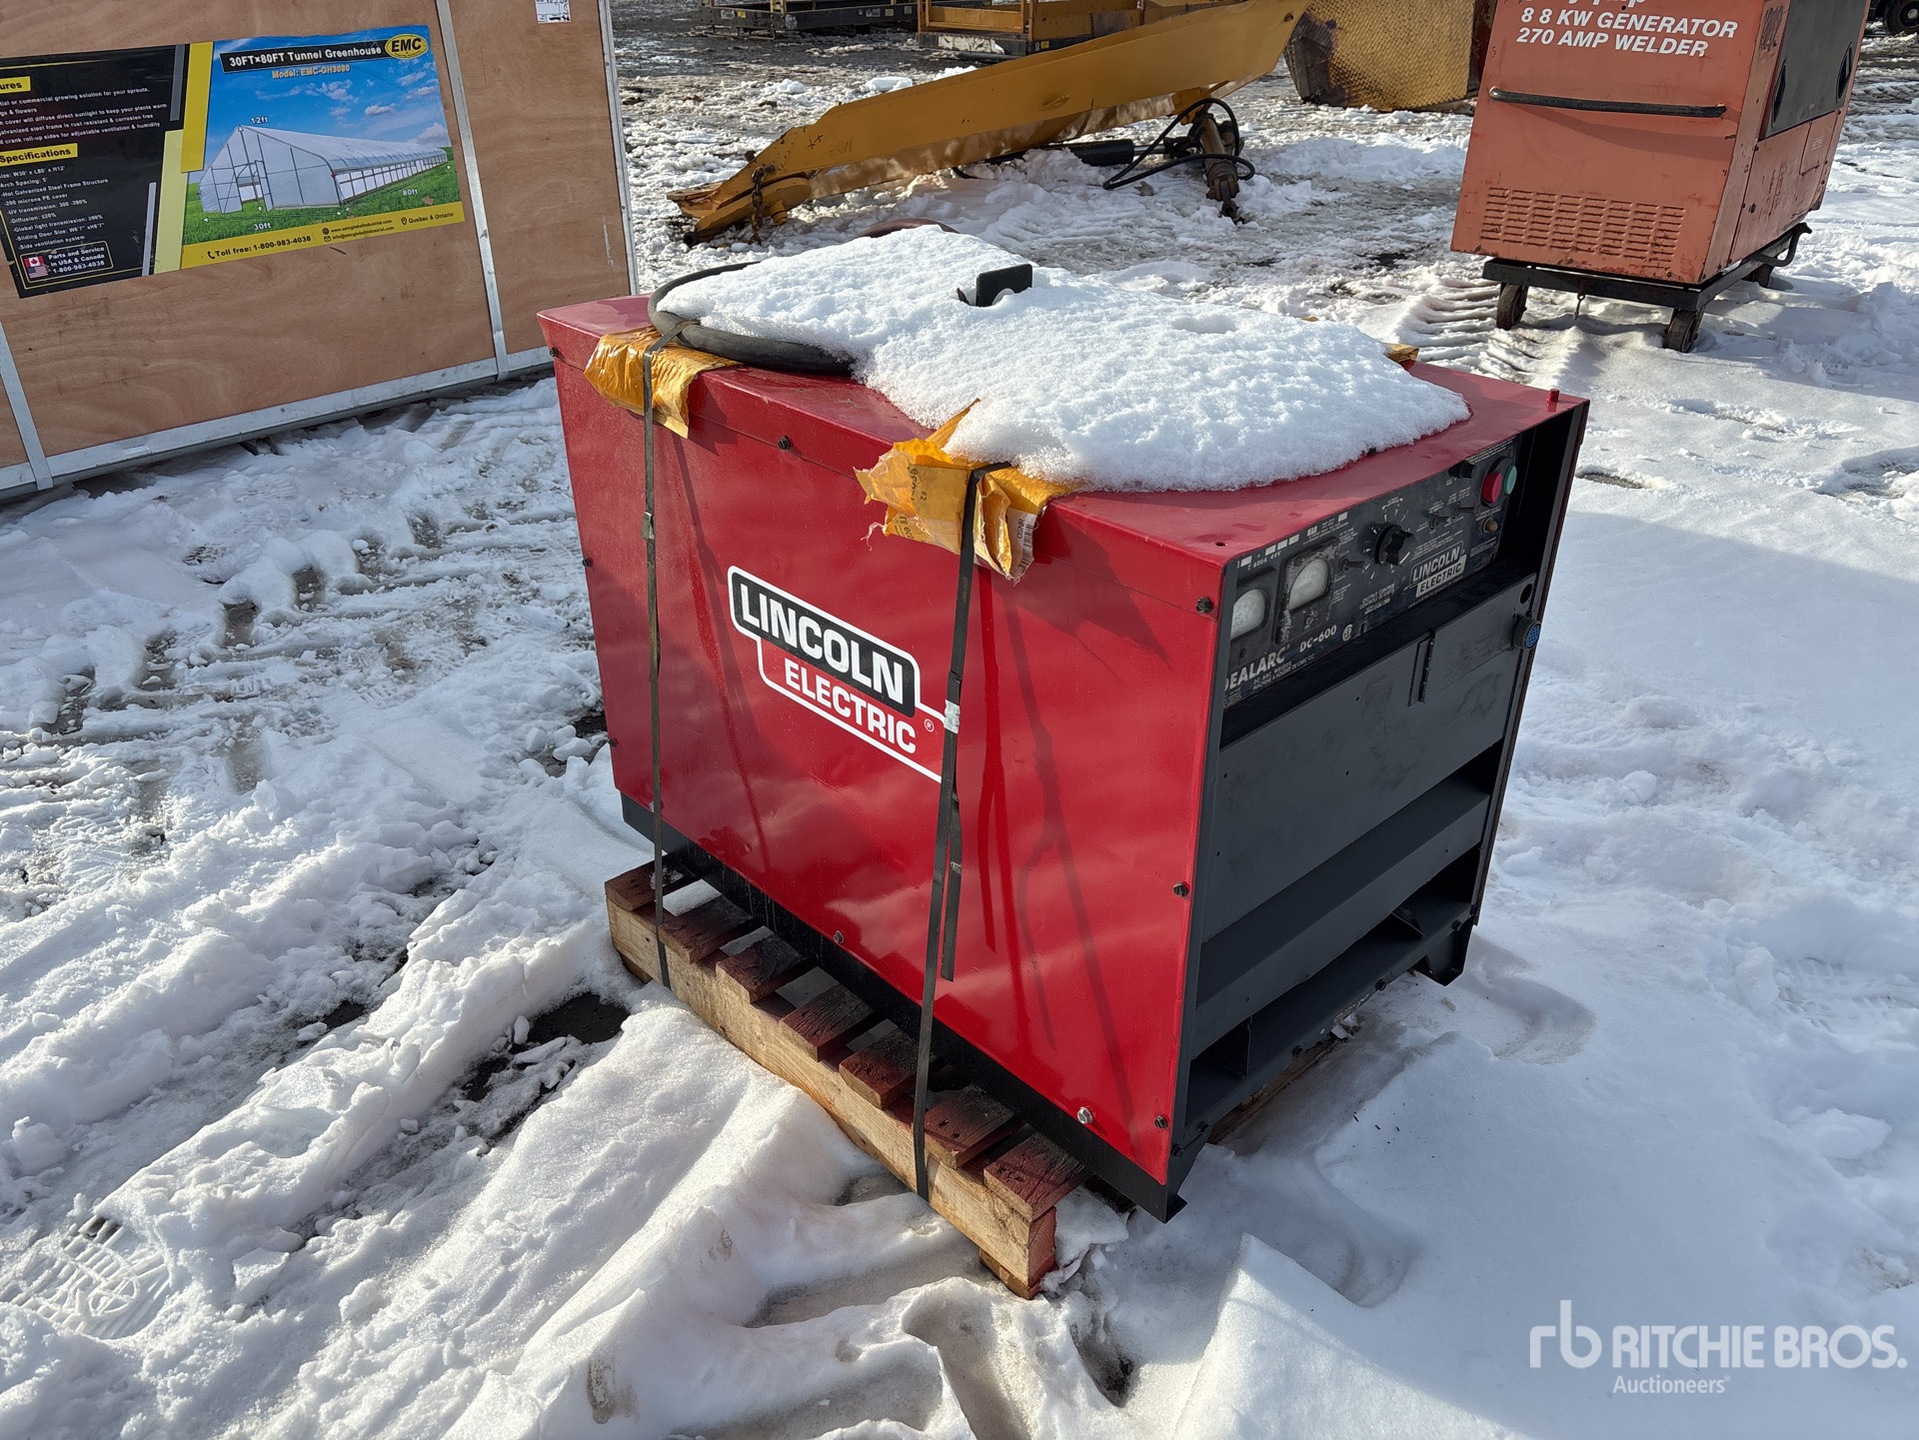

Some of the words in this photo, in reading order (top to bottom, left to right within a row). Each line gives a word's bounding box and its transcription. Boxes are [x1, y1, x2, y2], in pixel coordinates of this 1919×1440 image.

[1556, 9, 1594, 27] KW
[1597, 11, 1739, 39] GENERATOR
[391, 37, 422, 53] EMC
[1516, 27, 1555, 46] 270
[1557, 30, 1609, 49] AMP
[1614, 33, 1709, 57] WELDER
[287, 49, 322, 62] Tunnel
[325, 46, 382, 58] Greenhouse
[271, 68, 299, 79] Model:
[19, 96, 54, 104] commercial
[54, 94, 78, 102] growing
[30, 124, 45, 132] steel
[83, 118, 109, 126] resistant
[101, 125, 131, 133] ventilation
[0, 149, 71, 163] Specifications
[15, 186, 47, 196] Galvanized
[82, 178, 108, 186] Structure
[402, 188, 419, 197] 80ft
[408, 214, 429, 224] Quebec
[434, 211, 455, 220] Ontario
[253, 222, 271, 231] 30ft
[65, 235, 86, 243] system
[214, 248, 231, 257] Toll
[233, 246, 252, 255] free:
[253, 235, 312, 251] 1-800-983-4038
[48, 252, 66, 260] Parts
[67, 249, 80, 257] and
[80, 246, 105, 255] Service
[59, 257, 73, 266] USA
[80, 253, 105, 262] Canada
[53, 260, 105, 274] 1-800-983-4038
[1412, 546, 1461, 582] LINCOLN
[1420, 563, 1462, 593] ELECTRIC
[740, 583, 905, 706] LINCOLN
[1300, 624, 1337, 653] DC-600
[784, 657, 917, 755] ELECTRIC
